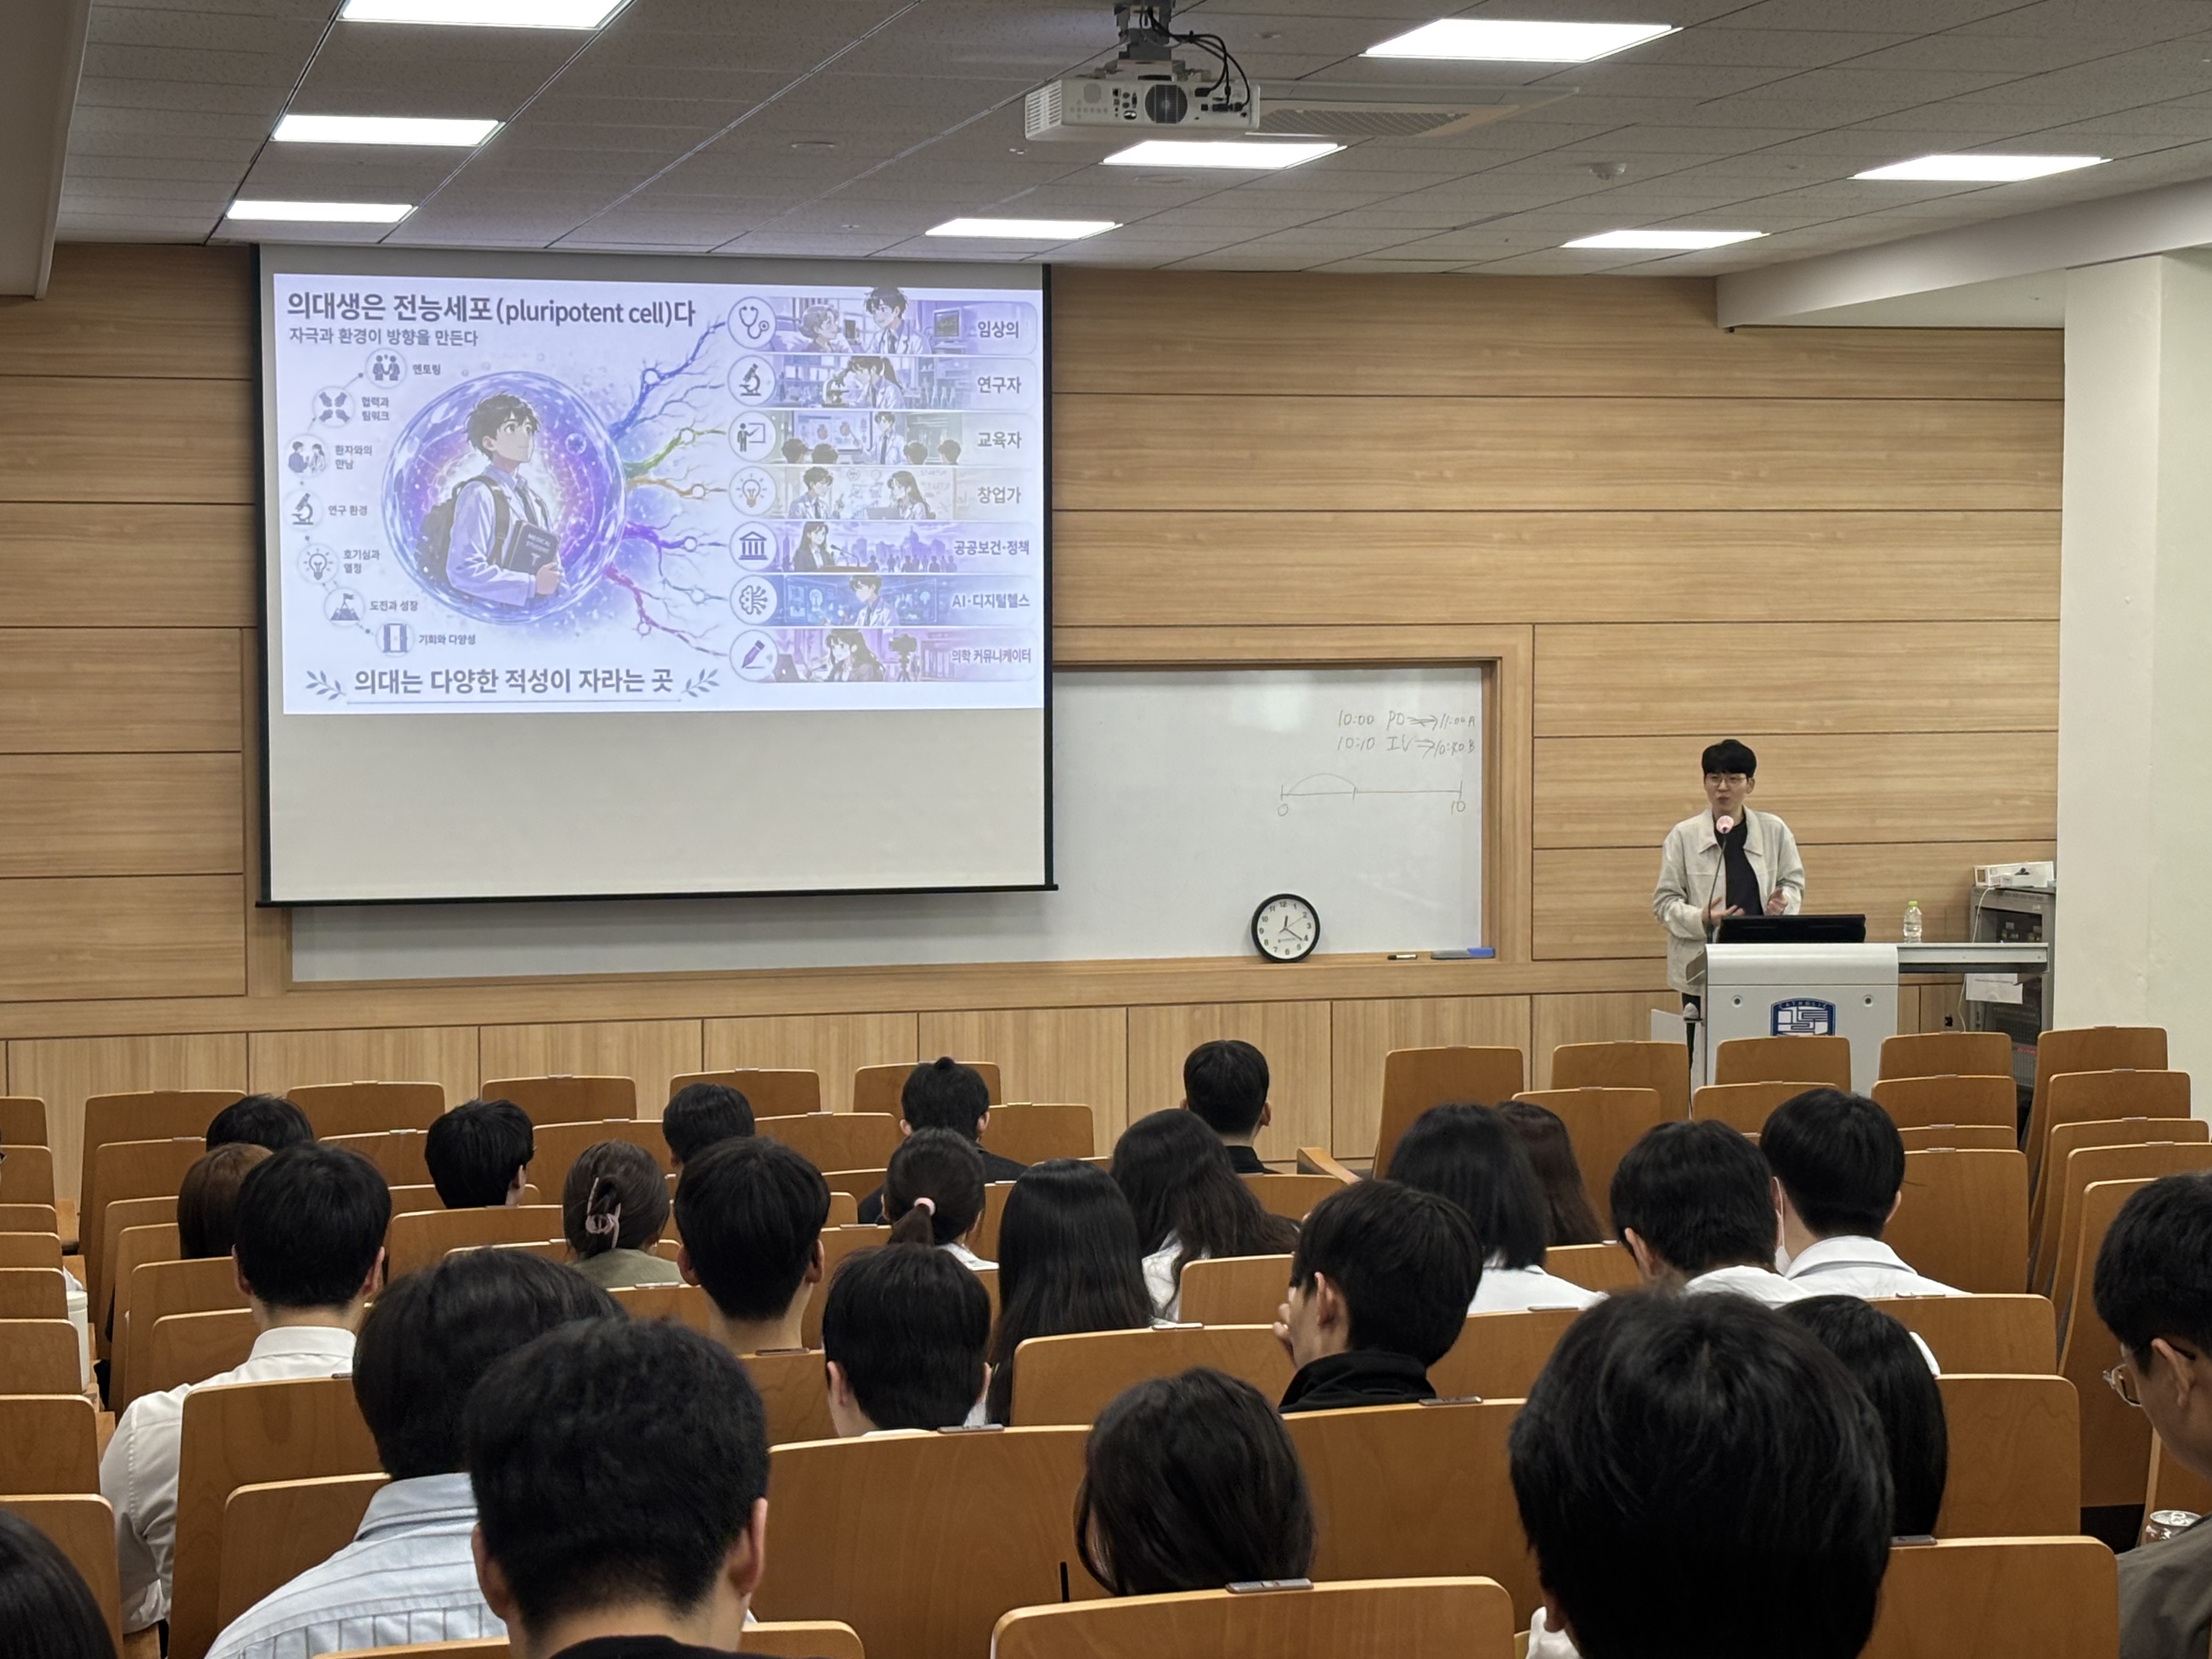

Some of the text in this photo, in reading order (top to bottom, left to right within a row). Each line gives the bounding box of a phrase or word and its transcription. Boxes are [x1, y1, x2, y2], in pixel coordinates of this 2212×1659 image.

[287, 292, 696, 328] 의대생은 전능세포(pluripotent cell)다
[977, 321, 1019, 338] 임상의
[290, 327, 478, 346] 자극과 환경이 방향을 만든다
[413, 364, 441, 375] 멘토링
[977, 376, 1022, 394] 연구자
[362, 396, 389, 408] 협력과
[362, 410, 390, 421] 팀워크
[977, 431, 1022, 449] 교육자
[335, 445, 372, 456] 환자와의
[335, 459, 353, 470] 만남
[977, 486, 1022, 504] 창업가
[329, 505, 367, 516] 연구 환경
[343, 550, 380, 560] 호기심과
[343, 563, 362, 574] 열정
[370, 601, 418, 611] 도전과 성장
[419, 634, 476, 645] 기회와 다양성
[952, 648, 1031, 663] 의학 커뮤니케이터
[354, 668, 674, 695] 의대는 다양한 적성이 자라는 곳
[1338, 710, 1374, 727] 10:00
[1338, 737, 1375, 751] 10:10
[1451, 801, 1465, 814] 10
